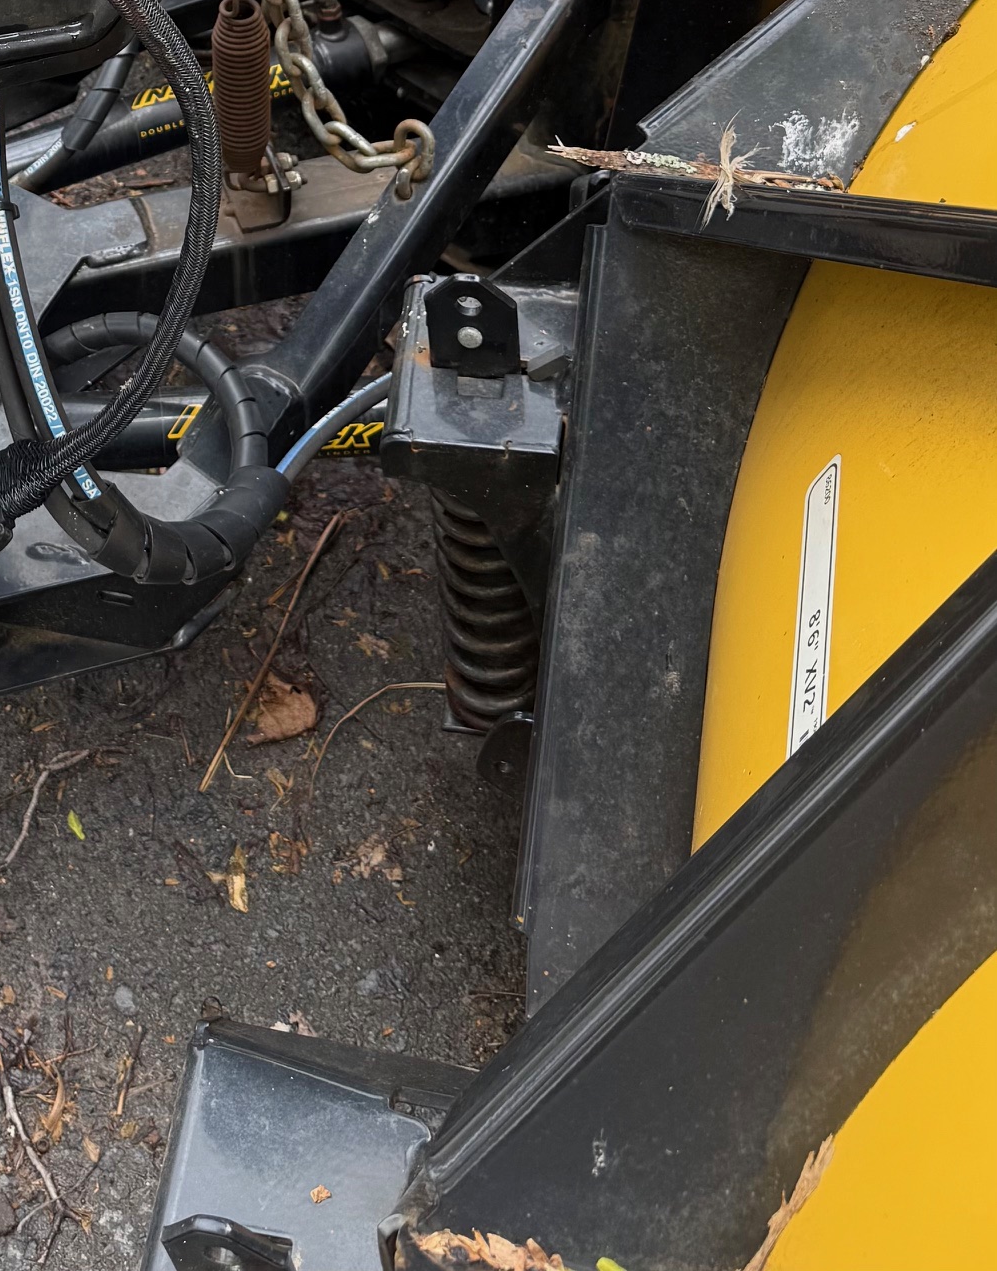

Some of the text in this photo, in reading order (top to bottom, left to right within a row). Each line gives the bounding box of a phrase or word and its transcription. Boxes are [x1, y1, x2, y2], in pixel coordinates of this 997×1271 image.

[140, 119, 185, 139] DOUBLE
[15, 311, 34, 350] DN10
[25, 352, 43, 378] DIN
[36, 380, 58, 424] 20022
